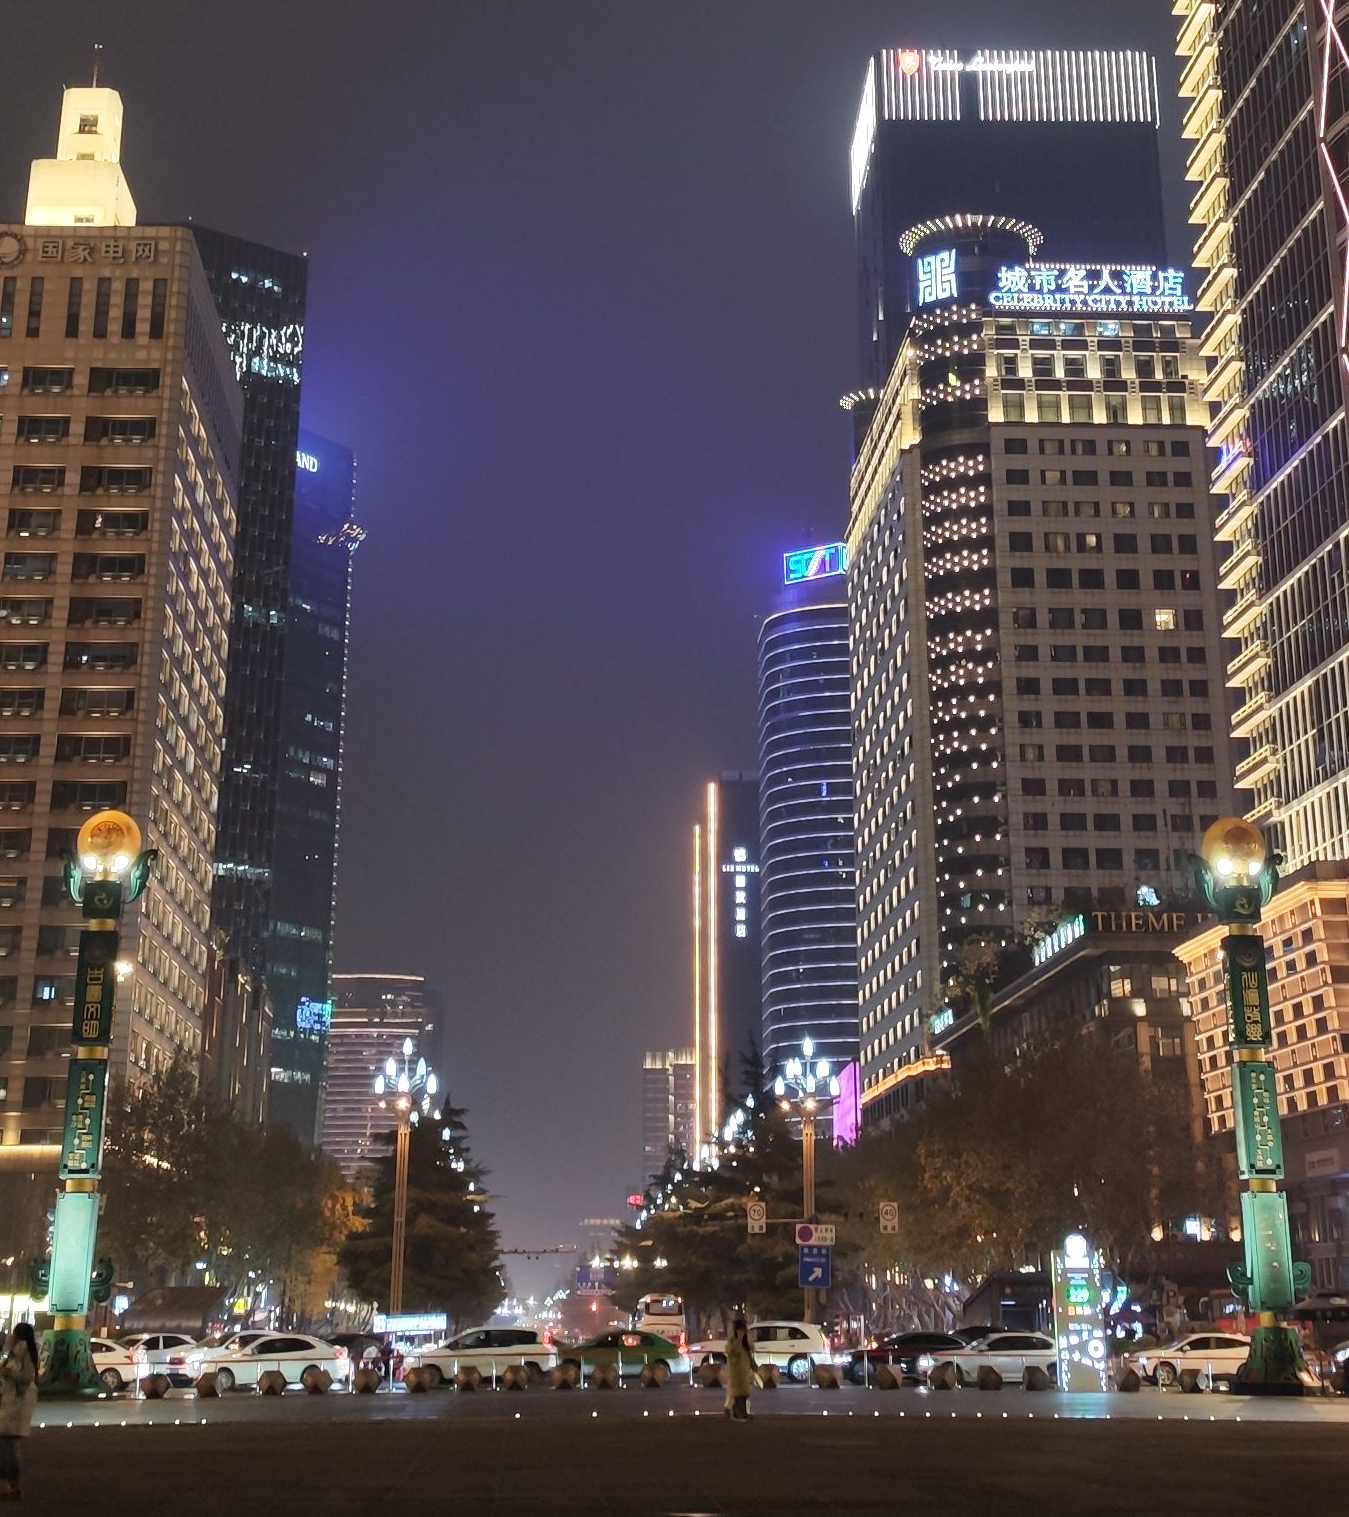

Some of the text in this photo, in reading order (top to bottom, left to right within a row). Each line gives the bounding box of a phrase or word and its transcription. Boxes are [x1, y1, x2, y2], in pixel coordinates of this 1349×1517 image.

[38, 237, 156, 264] 国家电网
[997, 266, 1186, 296] 城市名人酒店
[989, 292, 1194, 311] CELEBRITY CITY HOTEL
[1092, 911, 1186, 933] THEME
